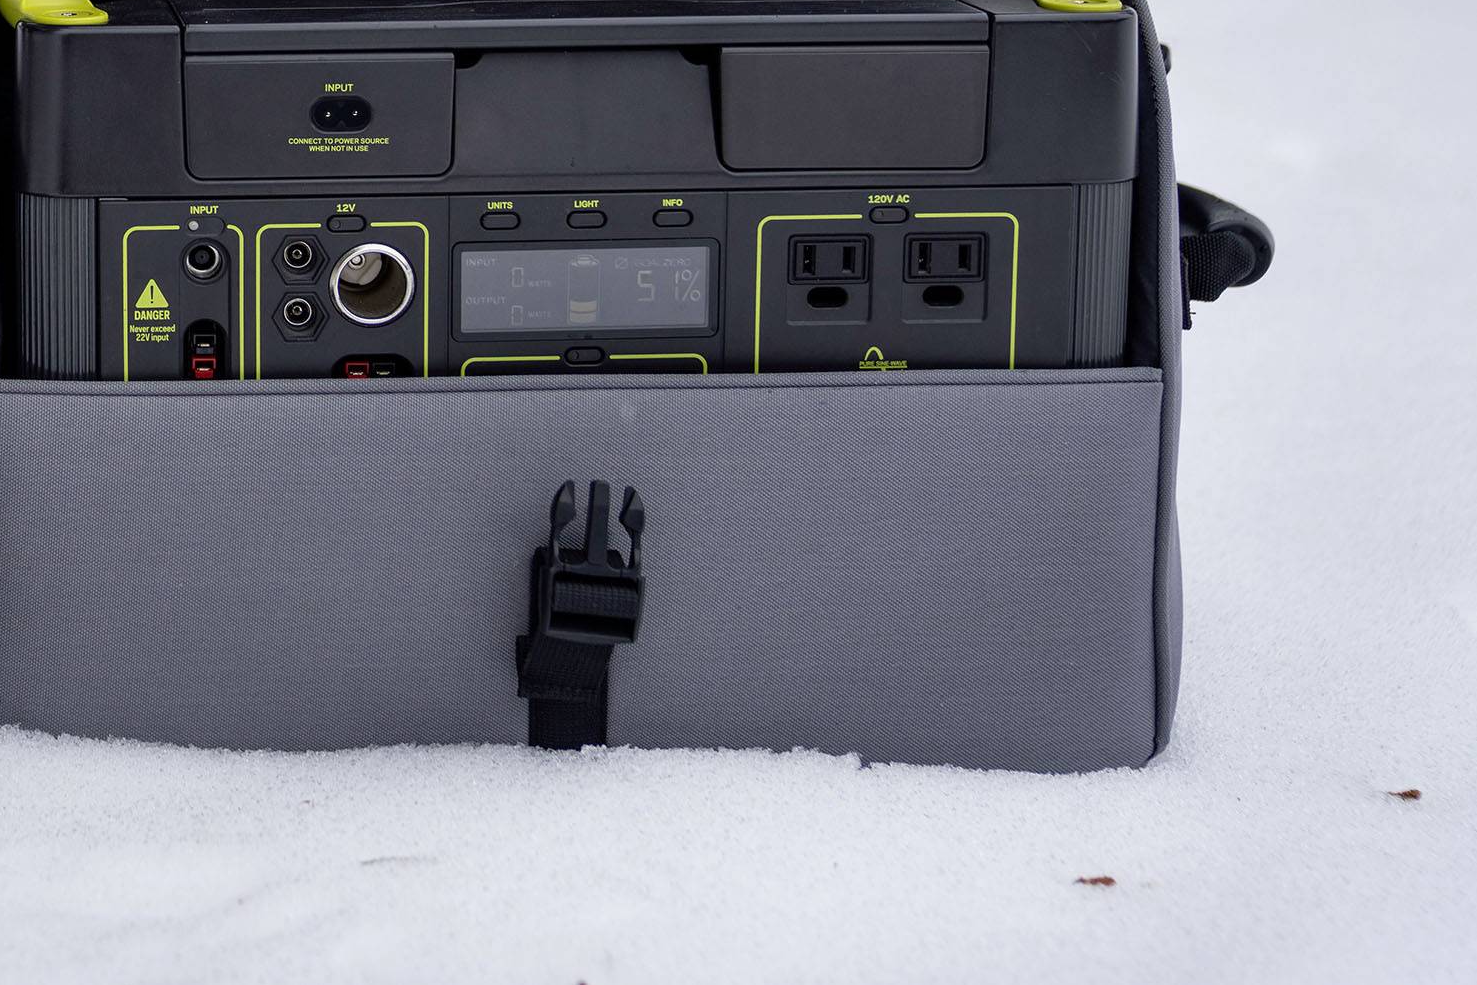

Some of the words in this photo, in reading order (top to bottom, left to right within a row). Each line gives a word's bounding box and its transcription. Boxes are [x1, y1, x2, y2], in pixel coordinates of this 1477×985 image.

[324, 83, 354, 92] INPUT
[574, 199, 599, 209] LIGHT
[662, 198, 683, 207] INFO
[868, 195, 894, 204] 120V
[896, 195, 910, 204] AC
[189, 205, 219, 215] INPUT
[336, 203, 356, 213] 12V
[487, 201, 513, 210] UNITS
[466, 258, 496, 267] INPUT
[466, 296, 507, 305] OUTPUT
[134, 310, 170, 321] DANGER
[129, 325, 149, 333] Never
[151, 324, 176, 332] exceed
[136, 334, 149, 342] 22V
[151, 333, 169, 343] input
